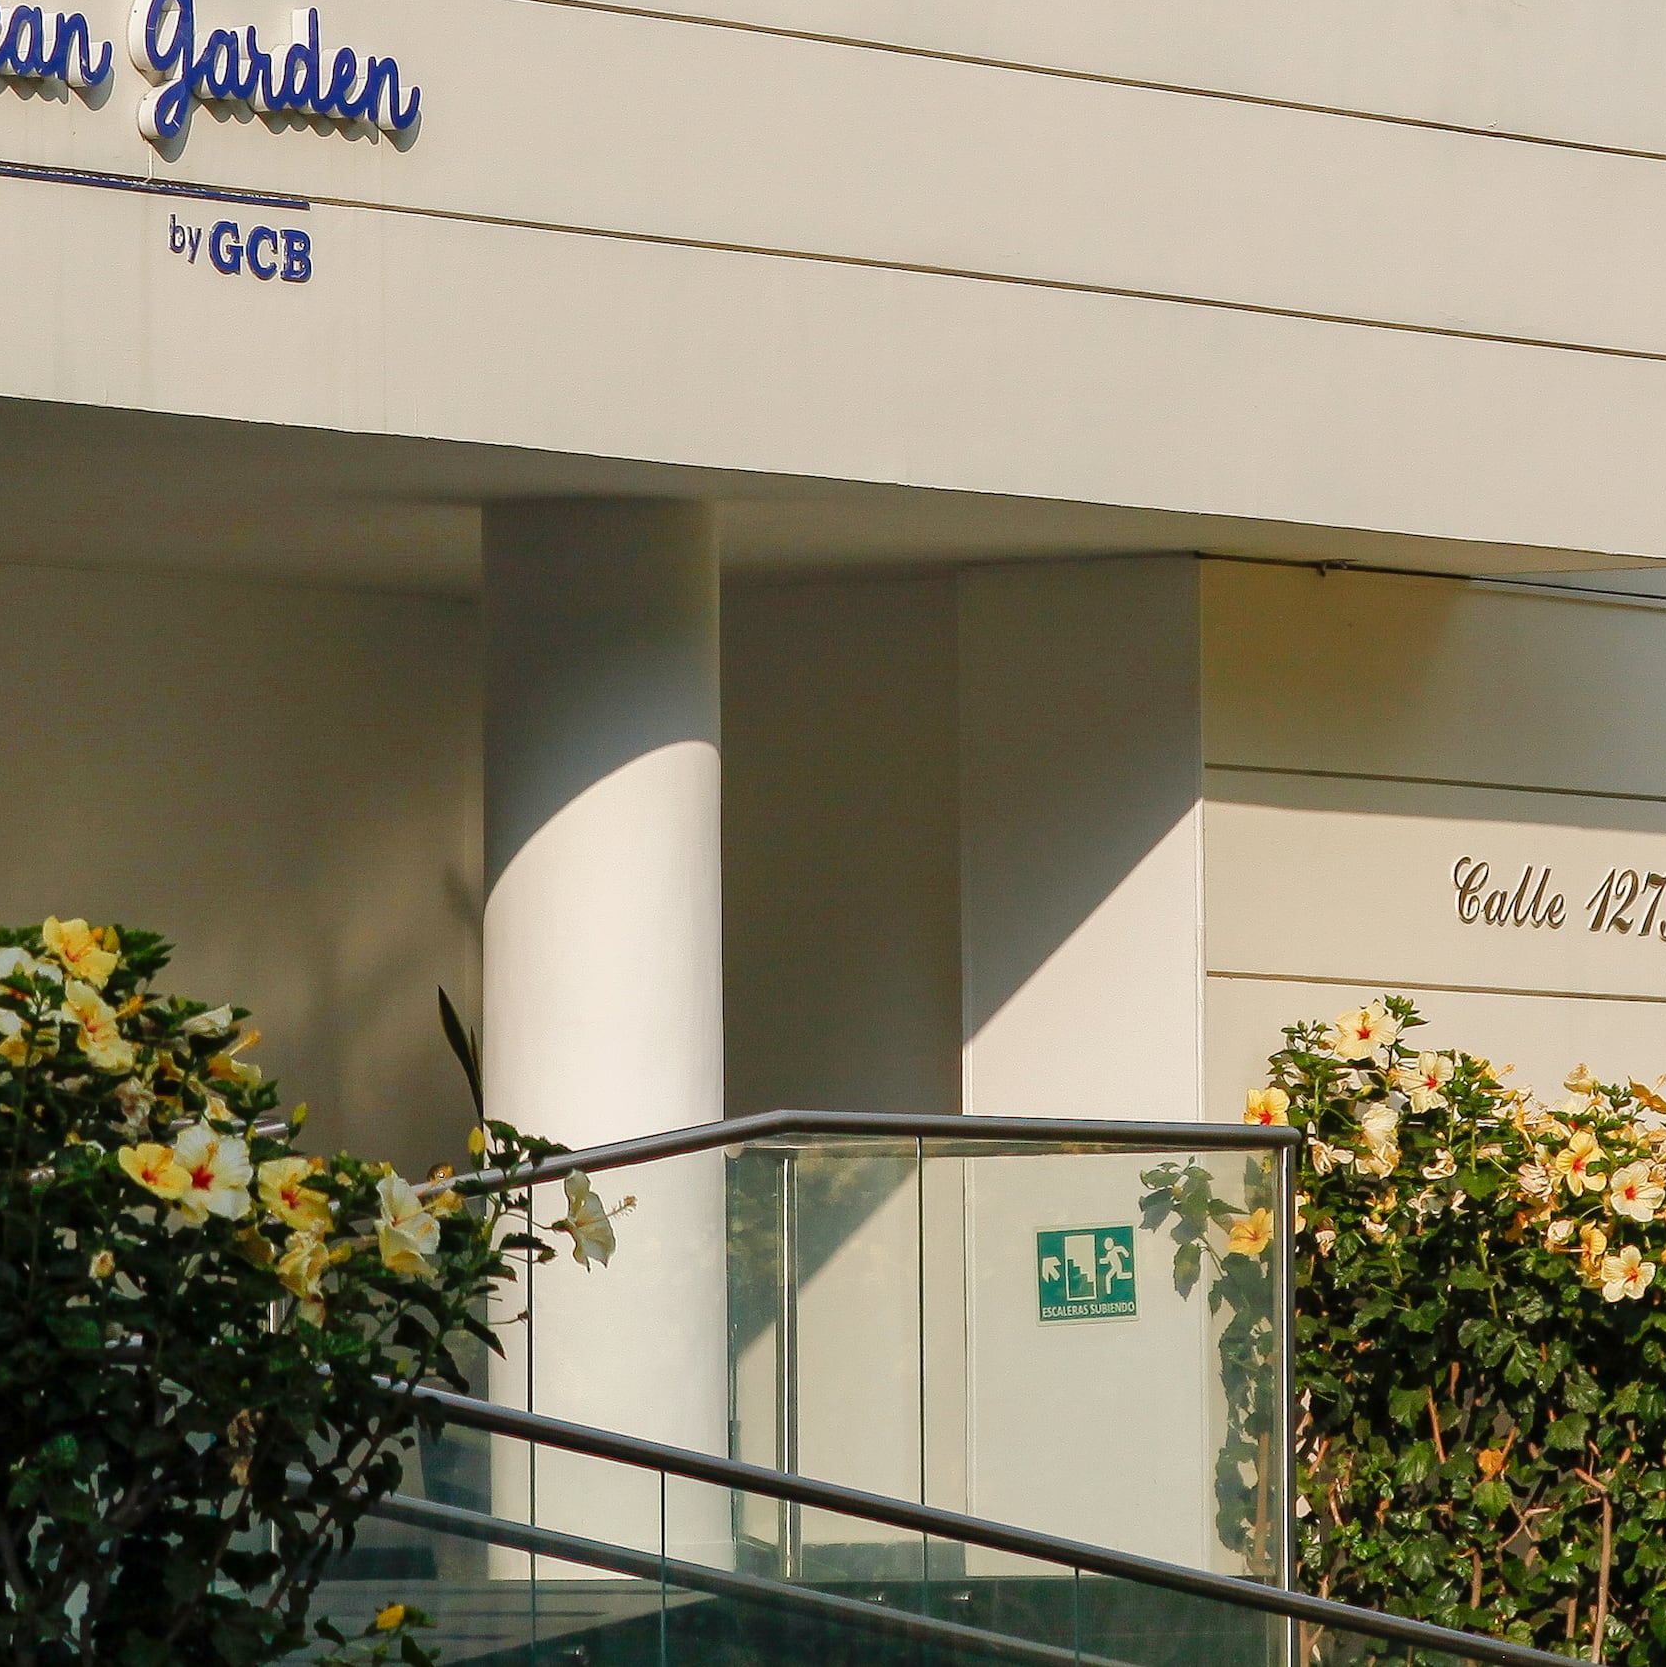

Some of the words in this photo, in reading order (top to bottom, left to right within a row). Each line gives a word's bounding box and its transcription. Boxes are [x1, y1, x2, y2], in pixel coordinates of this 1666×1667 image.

[169, 213, 202, 264] by
[209, 220, 312, 283] GCB
[1452, 856, 1567, 929] Calle
[1042, 1304, 1089, 1318] ESCALERAS
[1089, 1301, 1135, 1314] SUBIENDO
